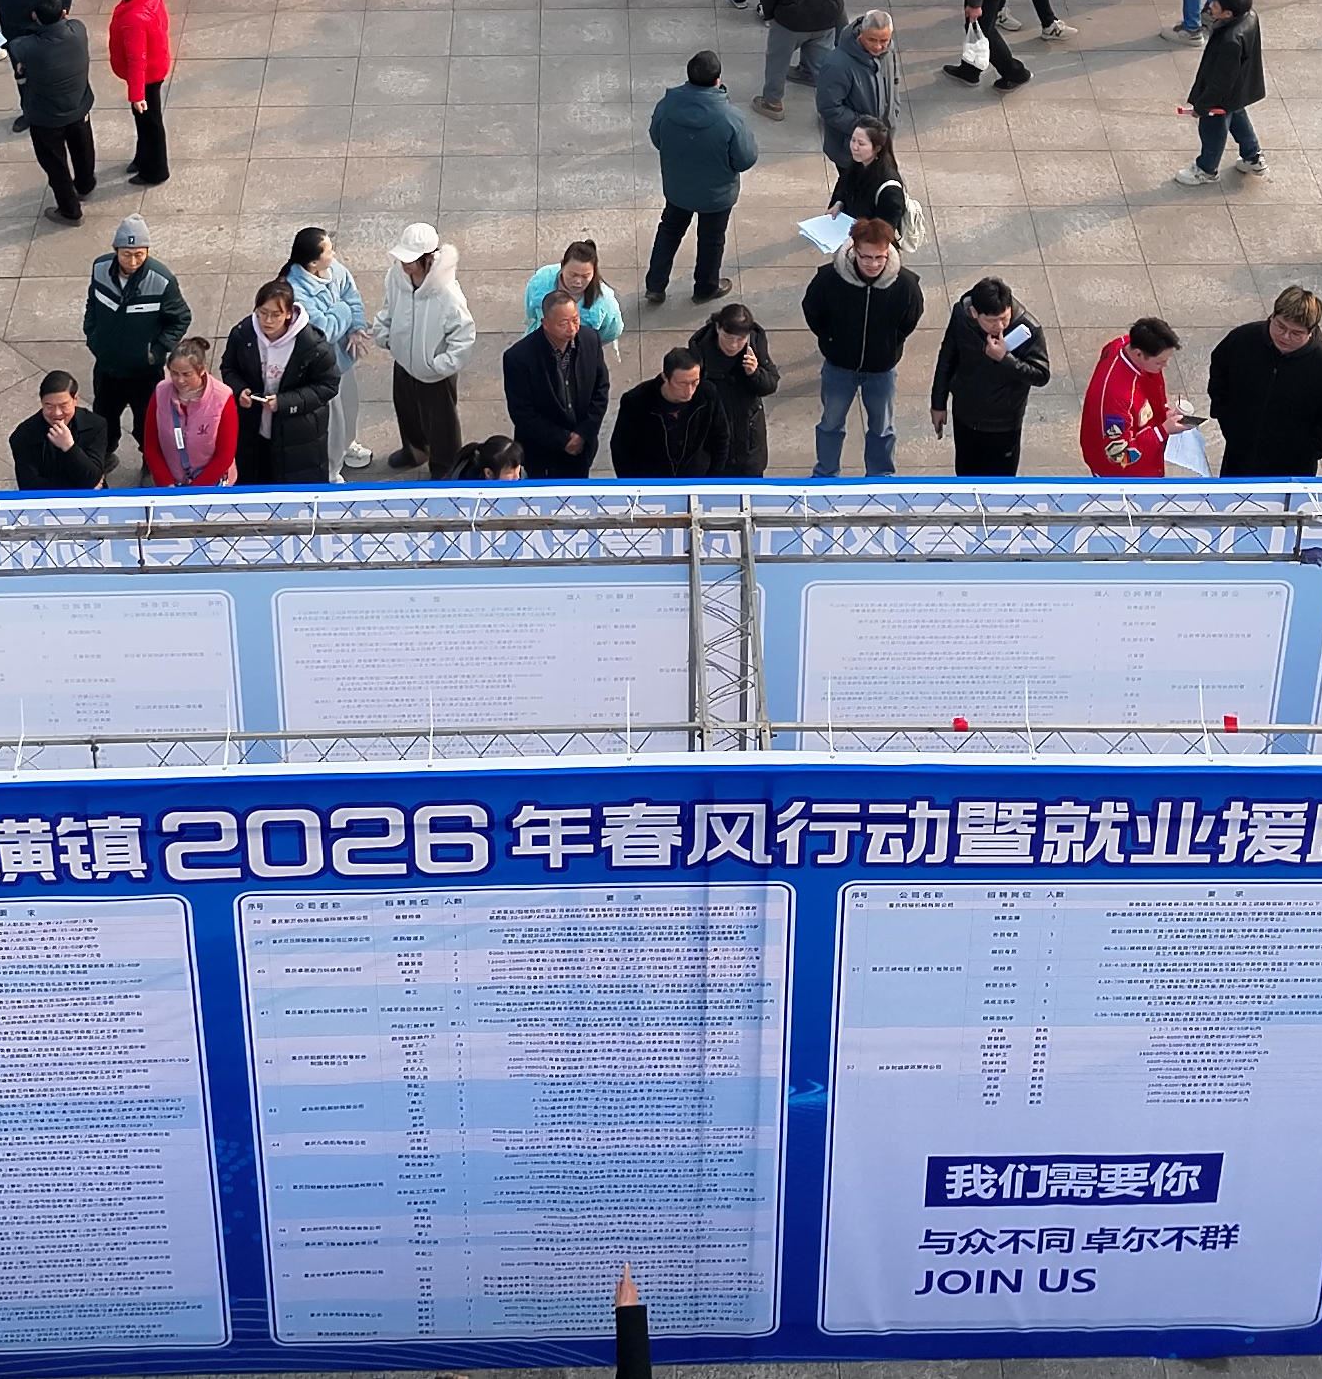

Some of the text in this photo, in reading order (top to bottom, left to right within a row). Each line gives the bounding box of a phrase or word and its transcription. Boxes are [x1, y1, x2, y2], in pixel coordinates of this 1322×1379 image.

[944, 1162, 1202, 1200] 我们需要你
[918, 1224, 1240, 1256] 与众不同 卓尔不群
[914, 1268, 1097, 1295] JOIN US
